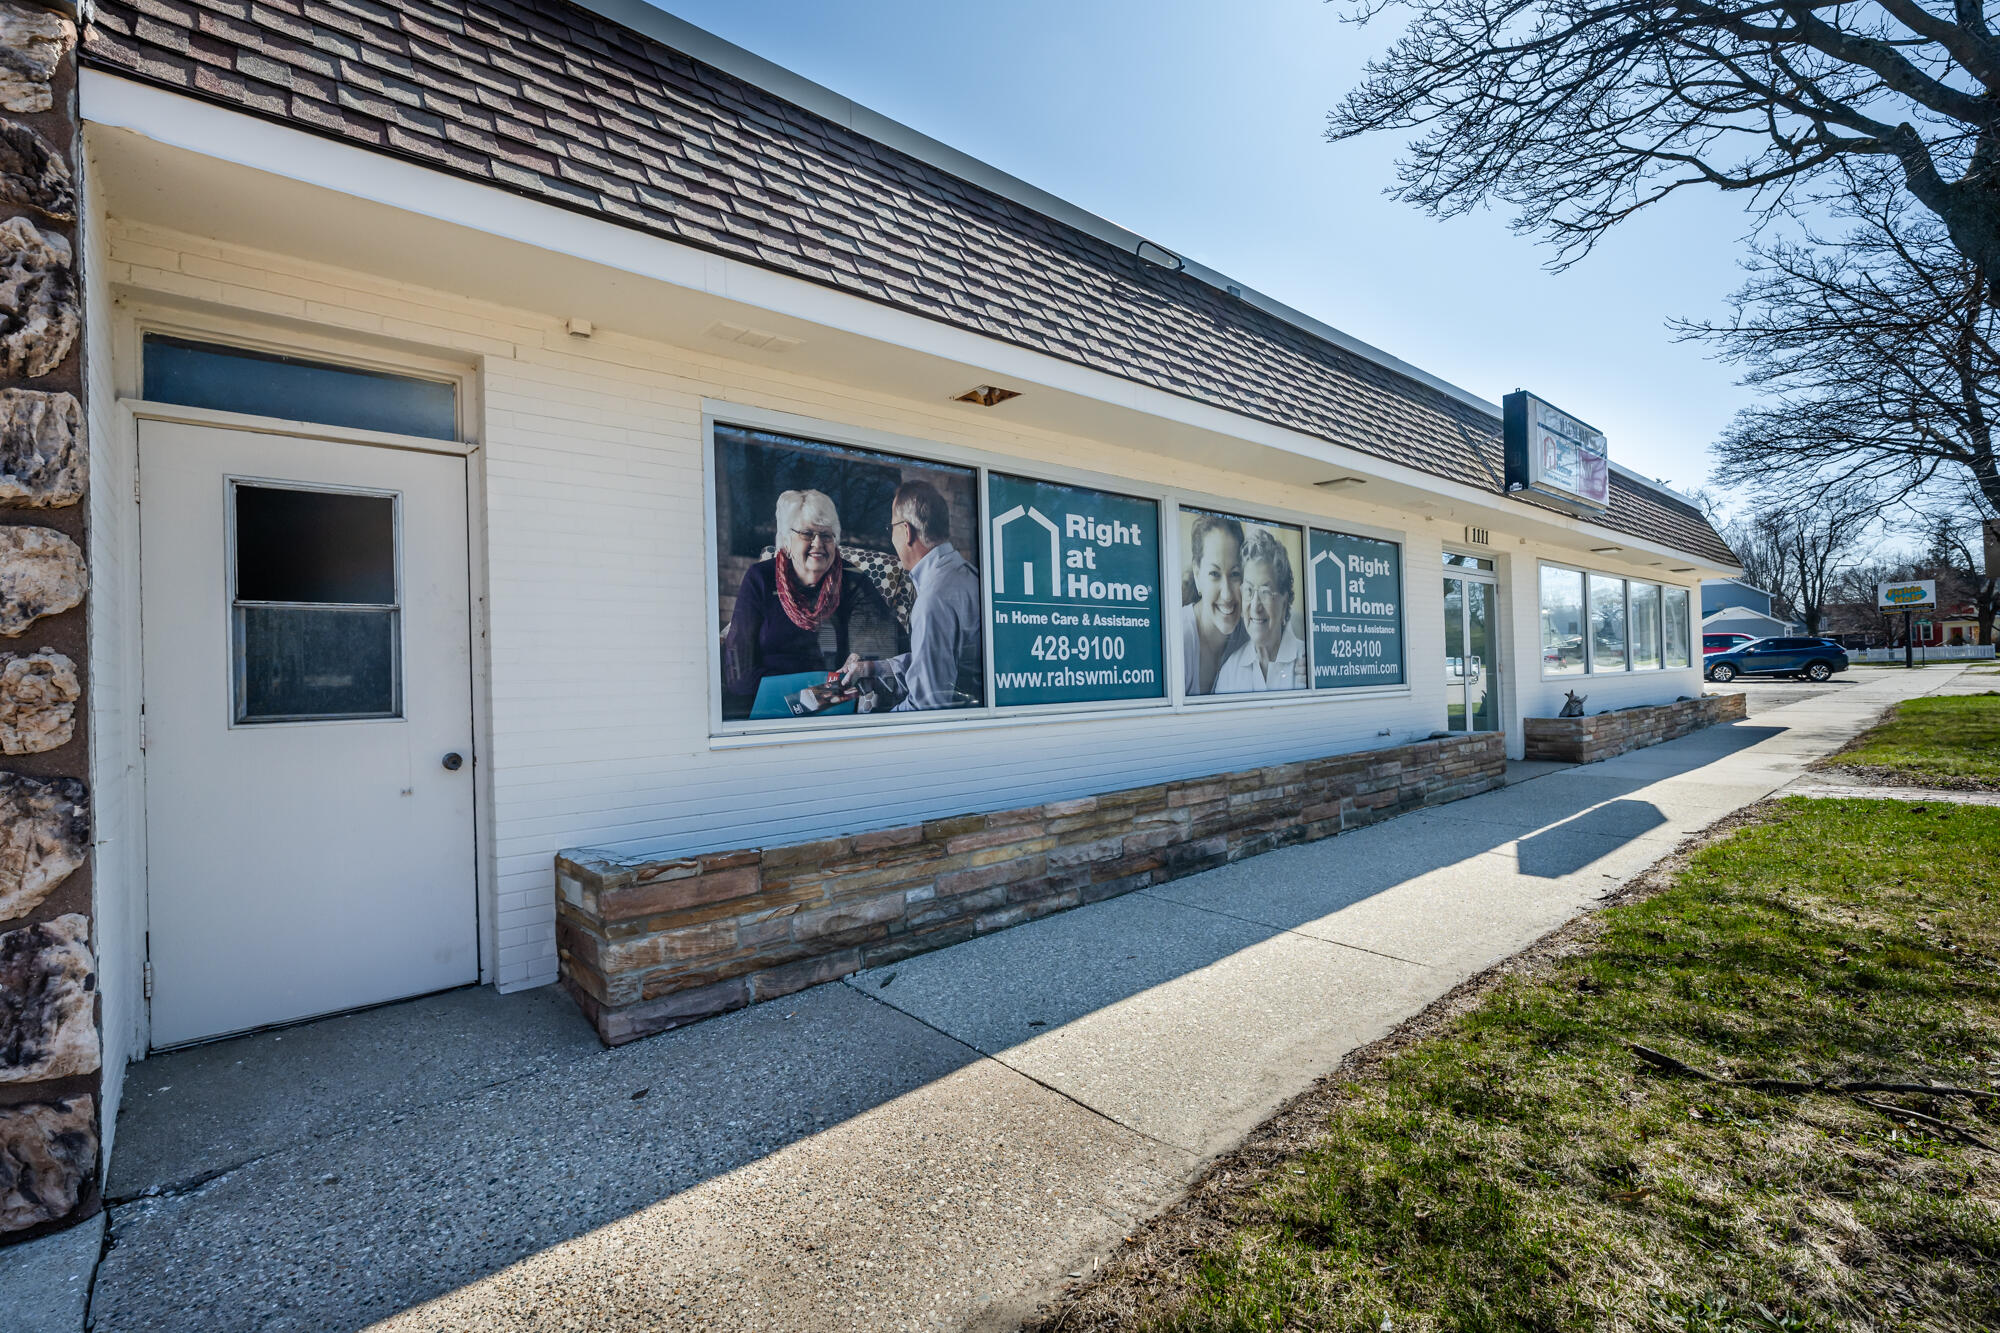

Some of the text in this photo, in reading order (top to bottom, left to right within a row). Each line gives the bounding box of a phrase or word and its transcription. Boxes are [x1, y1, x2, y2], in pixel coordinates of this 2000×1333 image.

[1066, 513, 1141, 547] Right
[1472, 528, 1488, 545] 1111
[1066, 547, 1096, 569] at
[1348, 555, 1390, 577] Right
[1067, 573, 1149, 601] Home
[1349, 577, 1365, 594] at
[1350, 596, 1394, 616] Home
[996, 610, 1150, 627] In Home Care & Assistance
[1321, 623, 1340, 632] Home
[1341, 624, 1356, 633] Care
[1358, 624, 1362, 633] &
[1364, 625, 1395, 634] Assistance
[1031, 635, 1125, 661] 428-9100
[1331, 640, 1381, 657] 428-9100
[995, 665, 1154, 688] www.rahswmi.com
[1315, 661, 1398, 677] www.rahswmi.com
